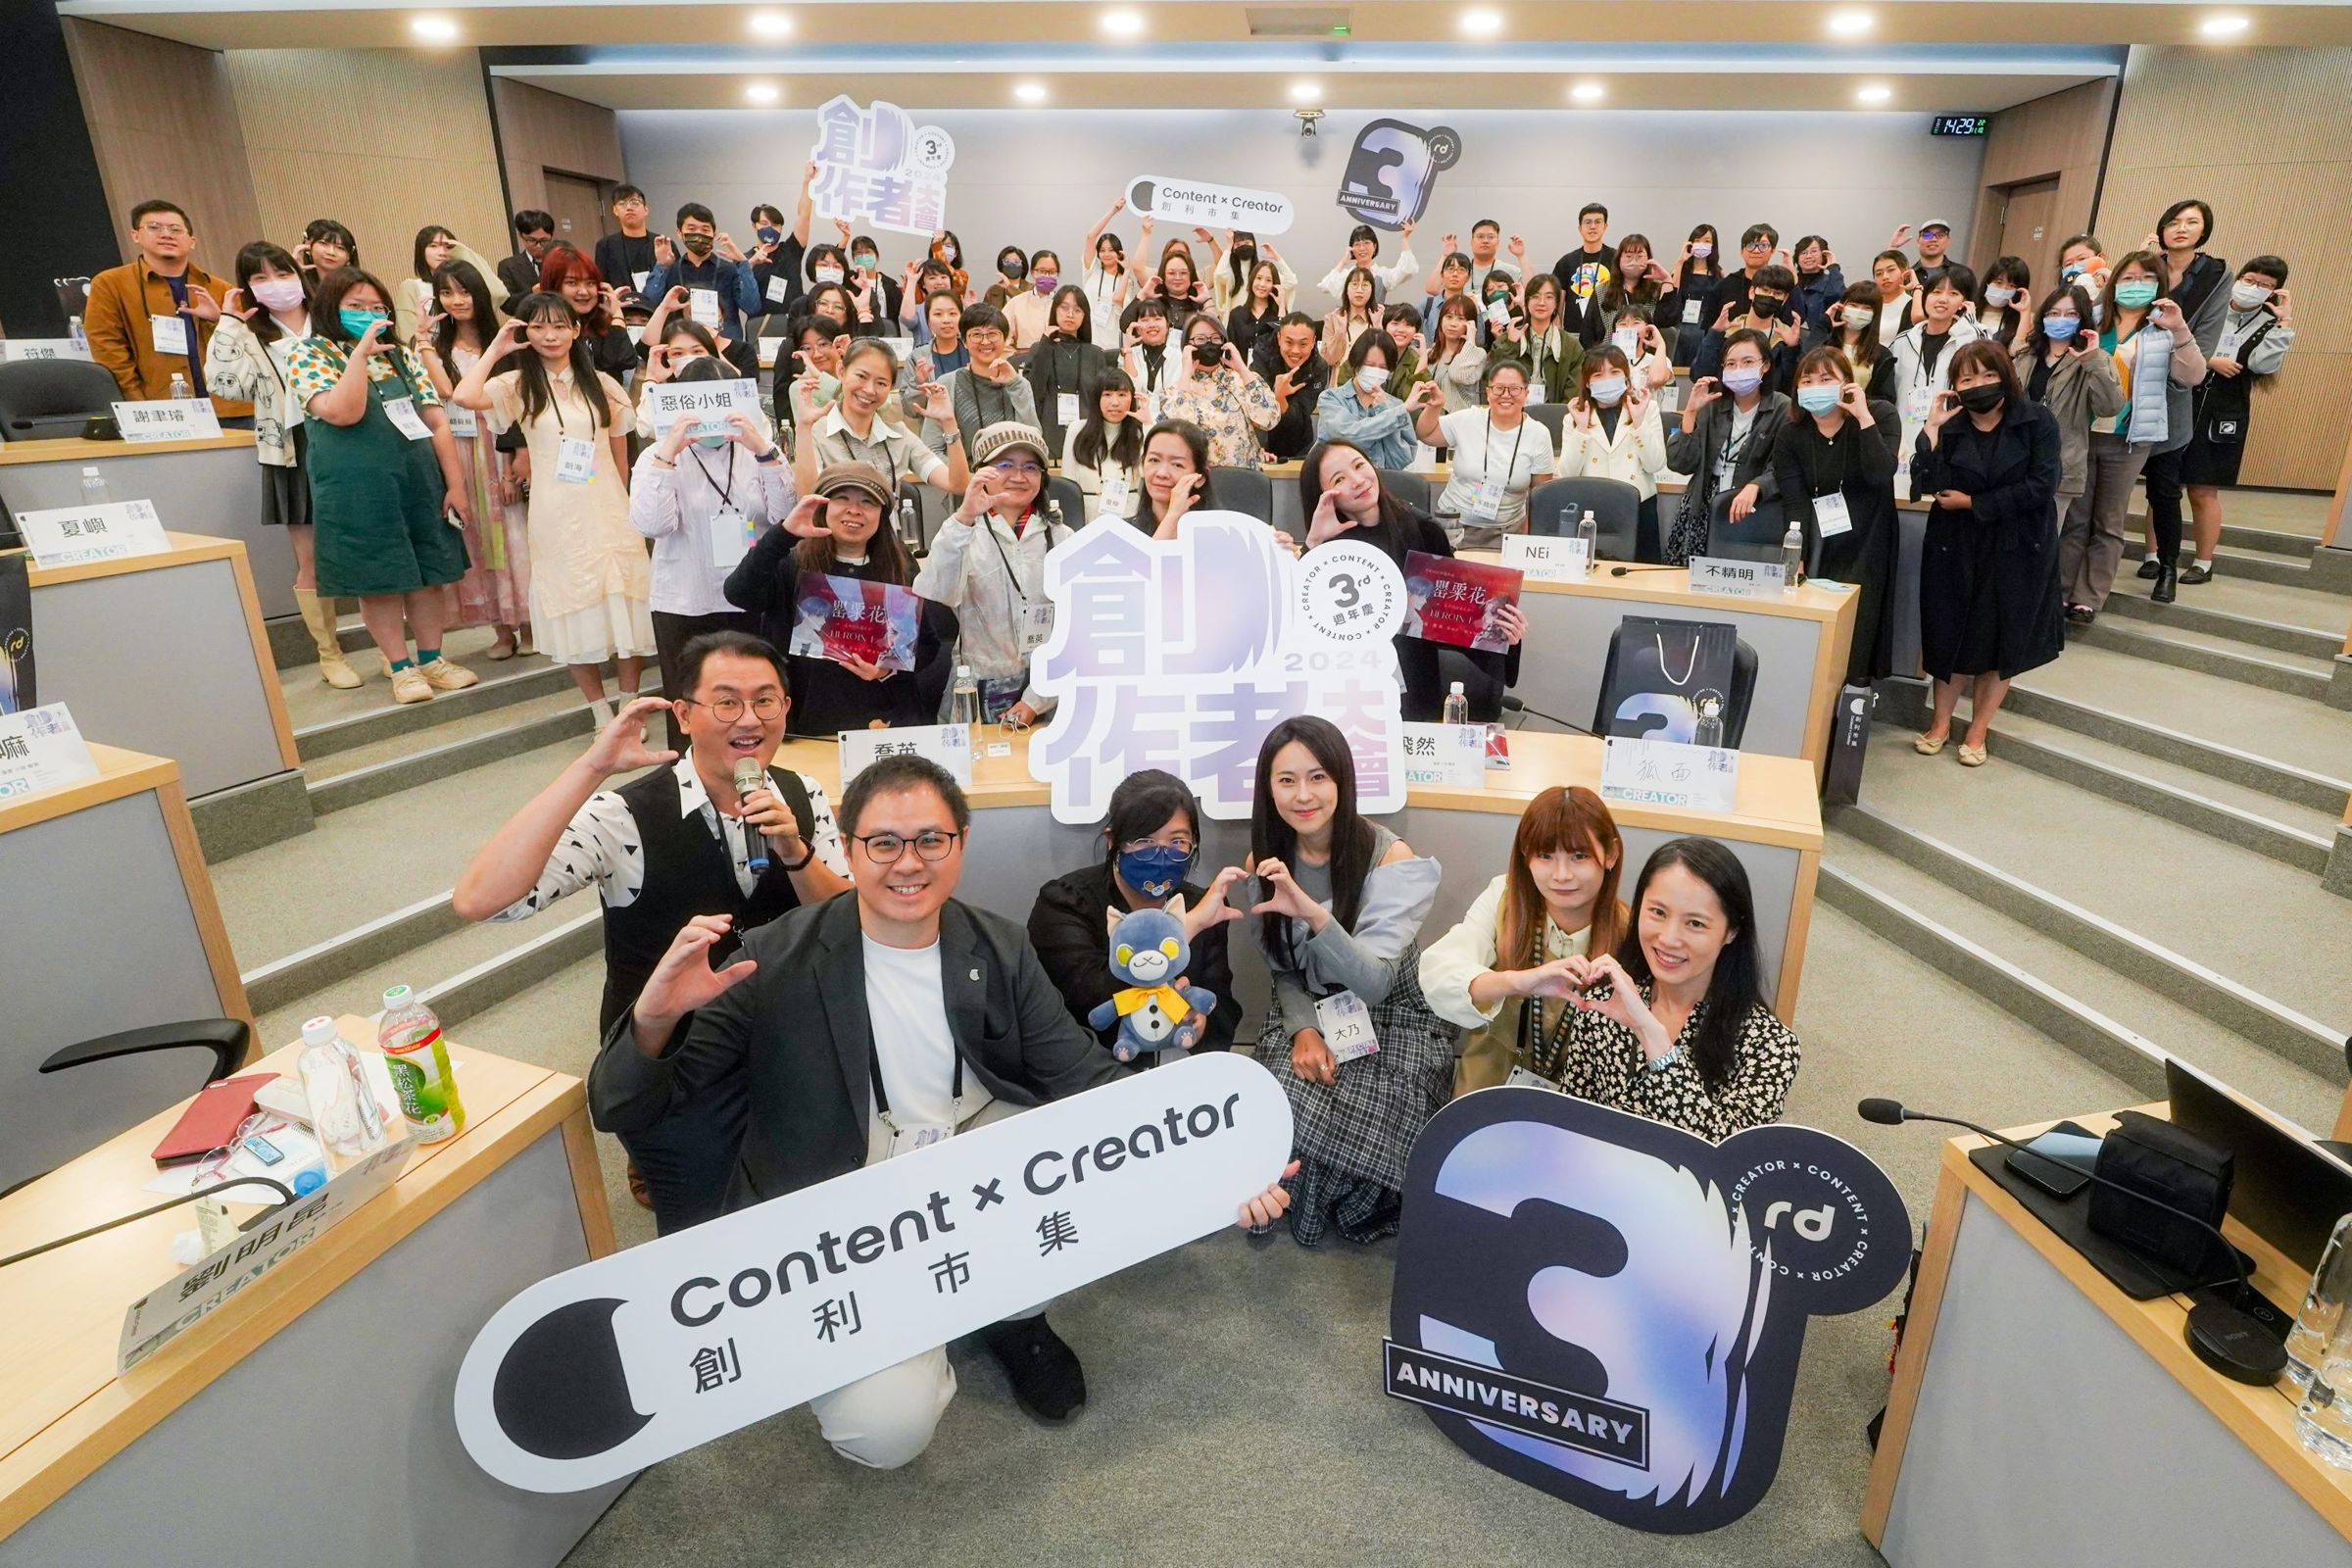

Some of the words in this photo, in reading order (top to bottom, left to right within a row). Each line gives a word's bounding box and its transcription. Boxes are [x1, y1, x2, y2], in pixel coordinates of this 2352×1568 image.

[1161, 201, 1240, 221] 創利市集
[1162, 187, 1217, 205] Content
[1231, 197, 1284, 214] Creator
[1340, 195, 1396, 211] ANNIVERSARY
[660, 392, 733, 412] 惡俗小姐
[57, 517, 109, 538] 夏嶼
[61, 545, 127, 562] CREATOR
[1332, 555, 1381, 573] CONTENT
[1525, 546, 1550, 560] NEi
[1705, 564, 1754, 581] 不精明
[1301, 565, 1322, 612] CREATOR
[1328, 573, 1372, 609] 3rd
[1433, 579, 1487, 606] 罌粟花
[832, 600, 887, 623] 罌粟花
[1046, 525, 1286, 681] 創
[1333, 603, 1375, 627] 週年慶
[1373, 583, 1393, 630] CREATOR
[1312, 621, 1363, 642] CONTENT
[1284, 650, 1383, 671] 2024
[1622, 788, 1689, 806] CREATOR
[392, 1063, 422, 1114] 黑松茶花
[1732, 1160, 1787, 1201] CREATOR
[1807, 1164, 1869, 1222] CONTENT
[669, 1190, 956, 1329] Content
[1022, 1093, 1243, 1198] Creator
[1763, 1200, 1836, 1242] rd
[1811, 1241, 1869, 1282] CREATOR
[174, 1226, 317, 1332] CREATOR
[688, 1209, 1082, 1396] 創利市集
[1396, 1361, 1634, 1446] ANNIVERSARY
